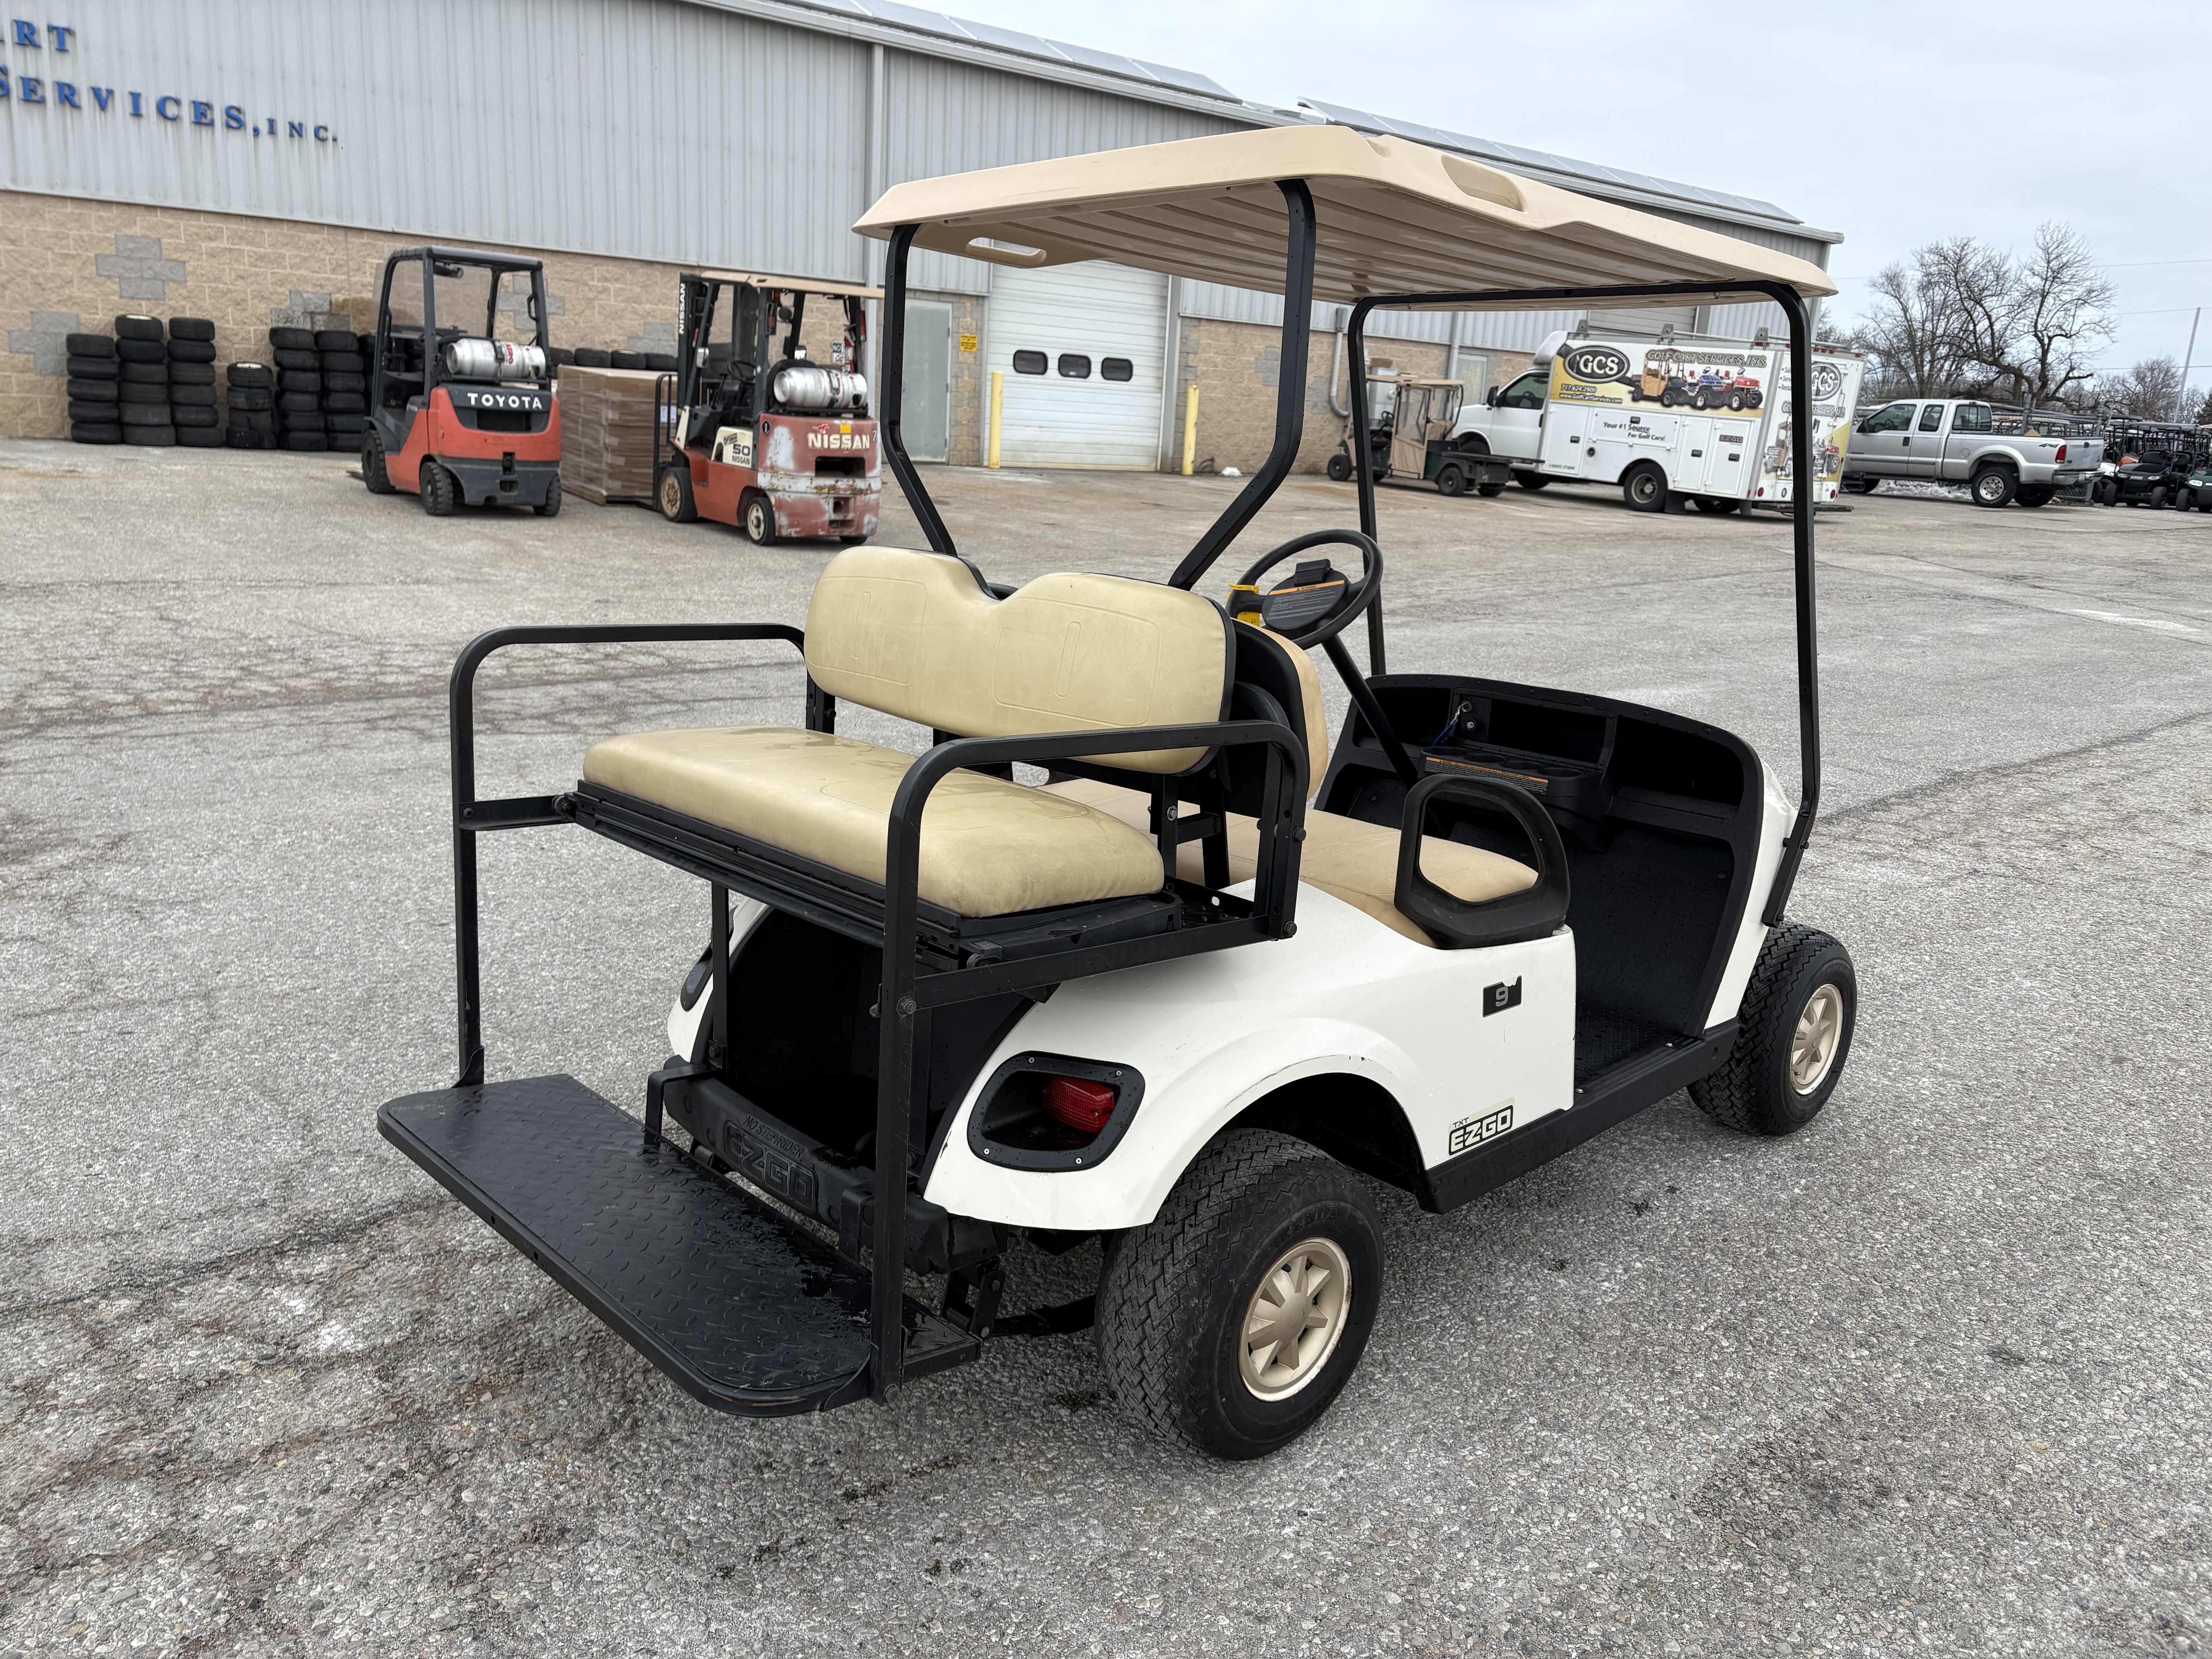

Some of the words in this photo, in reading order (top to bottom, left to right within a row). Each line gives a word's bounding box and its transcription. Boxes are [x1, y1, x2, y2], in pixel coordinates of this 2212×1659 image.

[0, 19, 76, 52] RT
[266, 117, 338, 142] INC.
[1580, 355, 1619, 375] GCS
[1812, 371, 1835, 392] GCS
[467, 392, 543, 409] TOYOTA
[1628, 424, 1650, 432] Source
[807, 432, 870, 450] NISSAN
[732, 444, 750, 456] 50
[732, 455, 750, 465] NISSAN
[1495, 986, 1508, 1006] 9
[743, 1116, 758, 1130] NO
[1453, 1117, 1469, 1128] TXT
